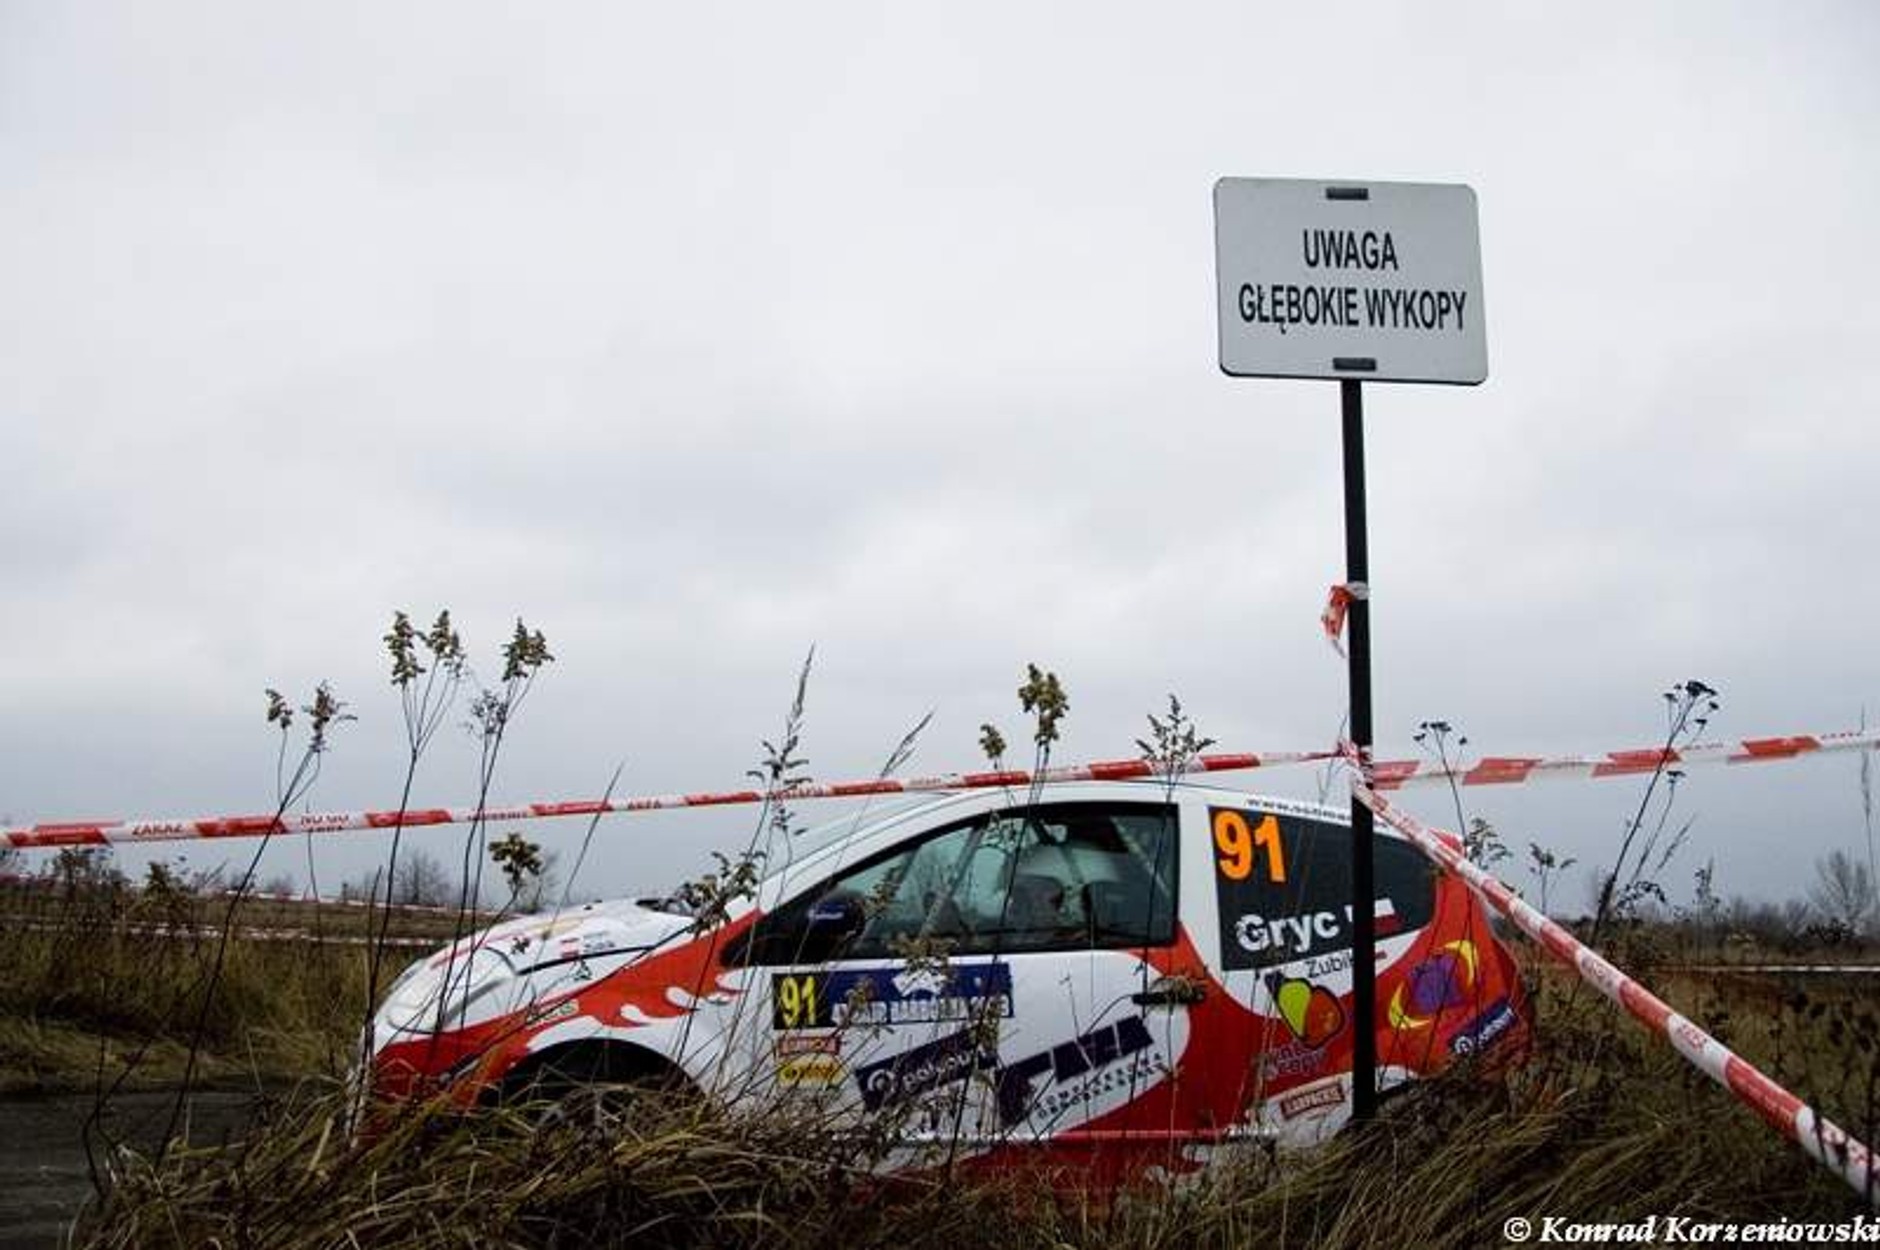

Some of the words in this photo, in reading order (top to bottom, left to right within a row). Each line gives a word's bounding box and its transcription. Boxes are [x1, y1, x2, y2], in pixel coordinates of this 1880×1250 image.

[1303, 229, 1399, 270] UWAGA
[1238, 283, 1360, 334] GŁĘBOKIE
[1365, 288, 1467, 331] WYKOPY
[1213, 810, 1286, 882] 91
[1234, 911, 1341, 952] Gryc
[780, 975, 816, 1028] 91
